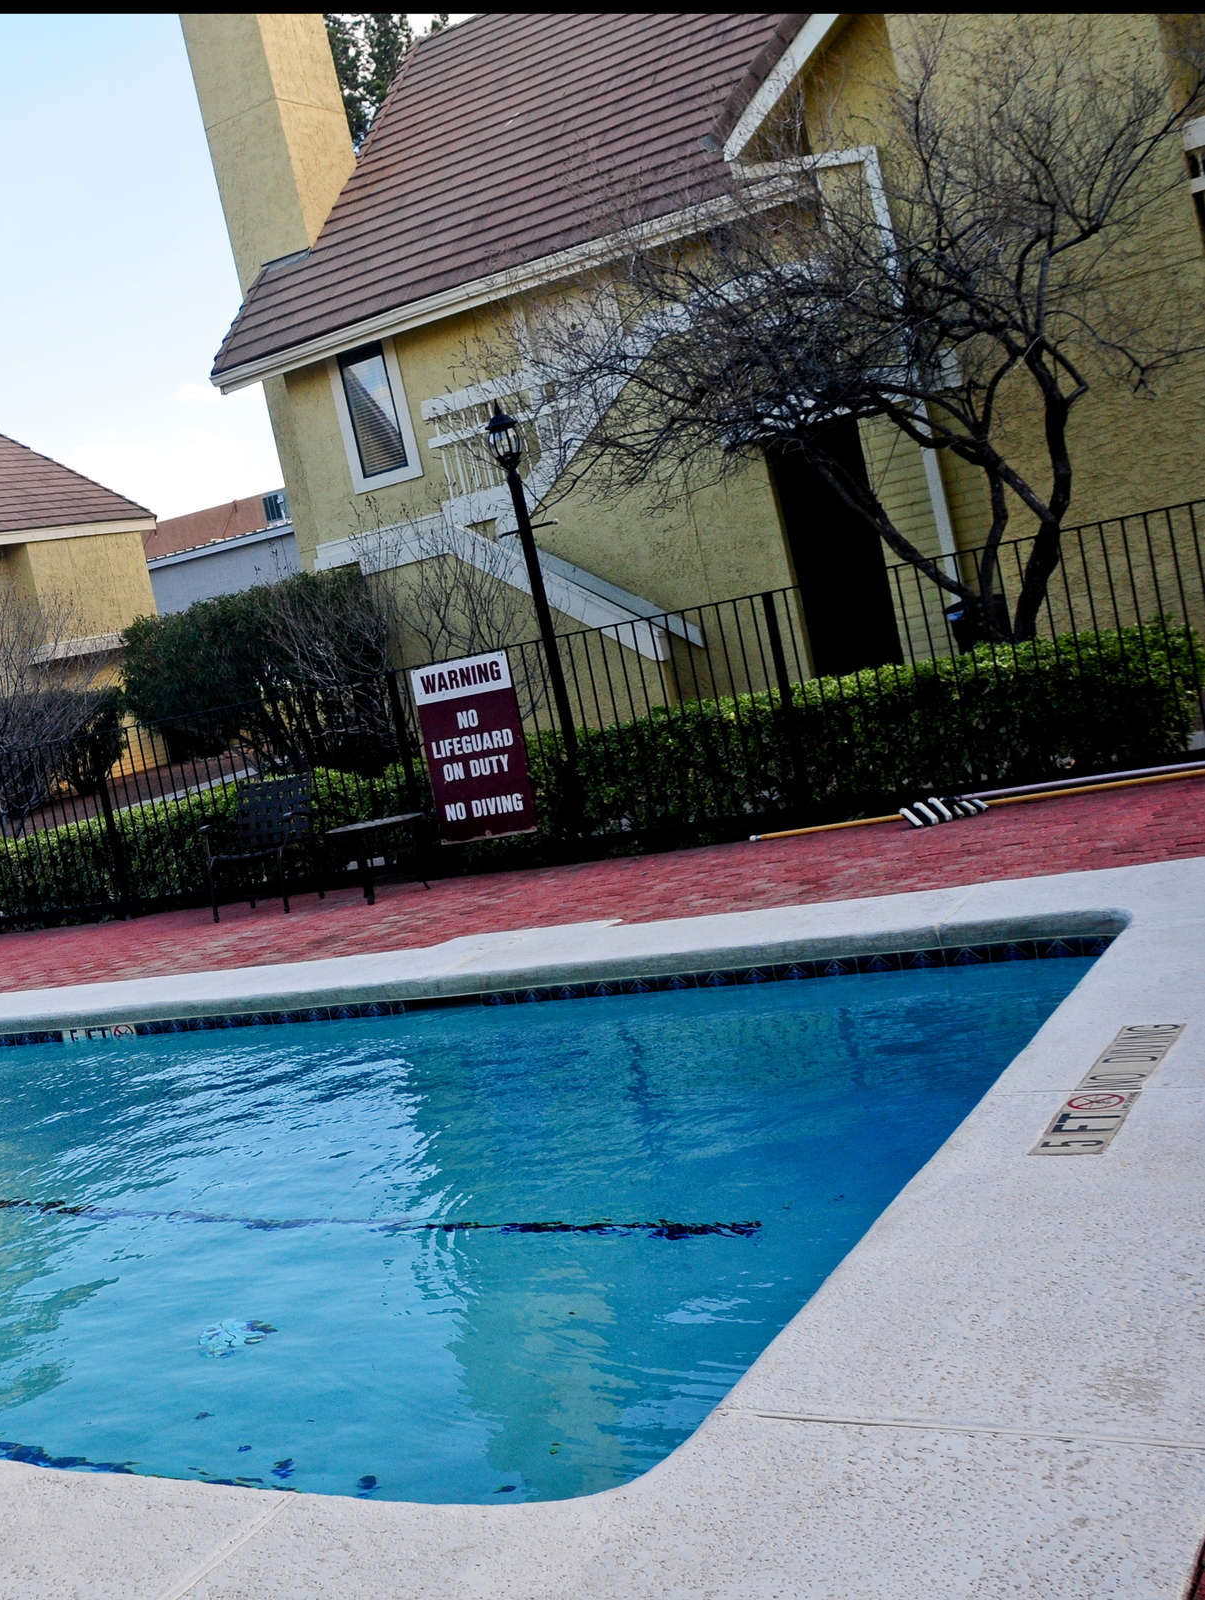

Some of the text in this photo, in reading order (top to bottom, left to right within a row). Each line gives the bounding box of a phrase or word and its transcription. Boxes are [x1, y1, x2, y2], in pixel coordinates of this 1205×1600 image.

[420, 660, 502, 695] WARNING
[456, 708, 479, 729] NO
[431, 728, 514, 760] LIFEGUARD
[443, 753, 509, 782] ON DUTY
[444, 792, 524, 822] NO DIVING
[1040, 1023, 1181, 1148] 5 FT NO DIVING
